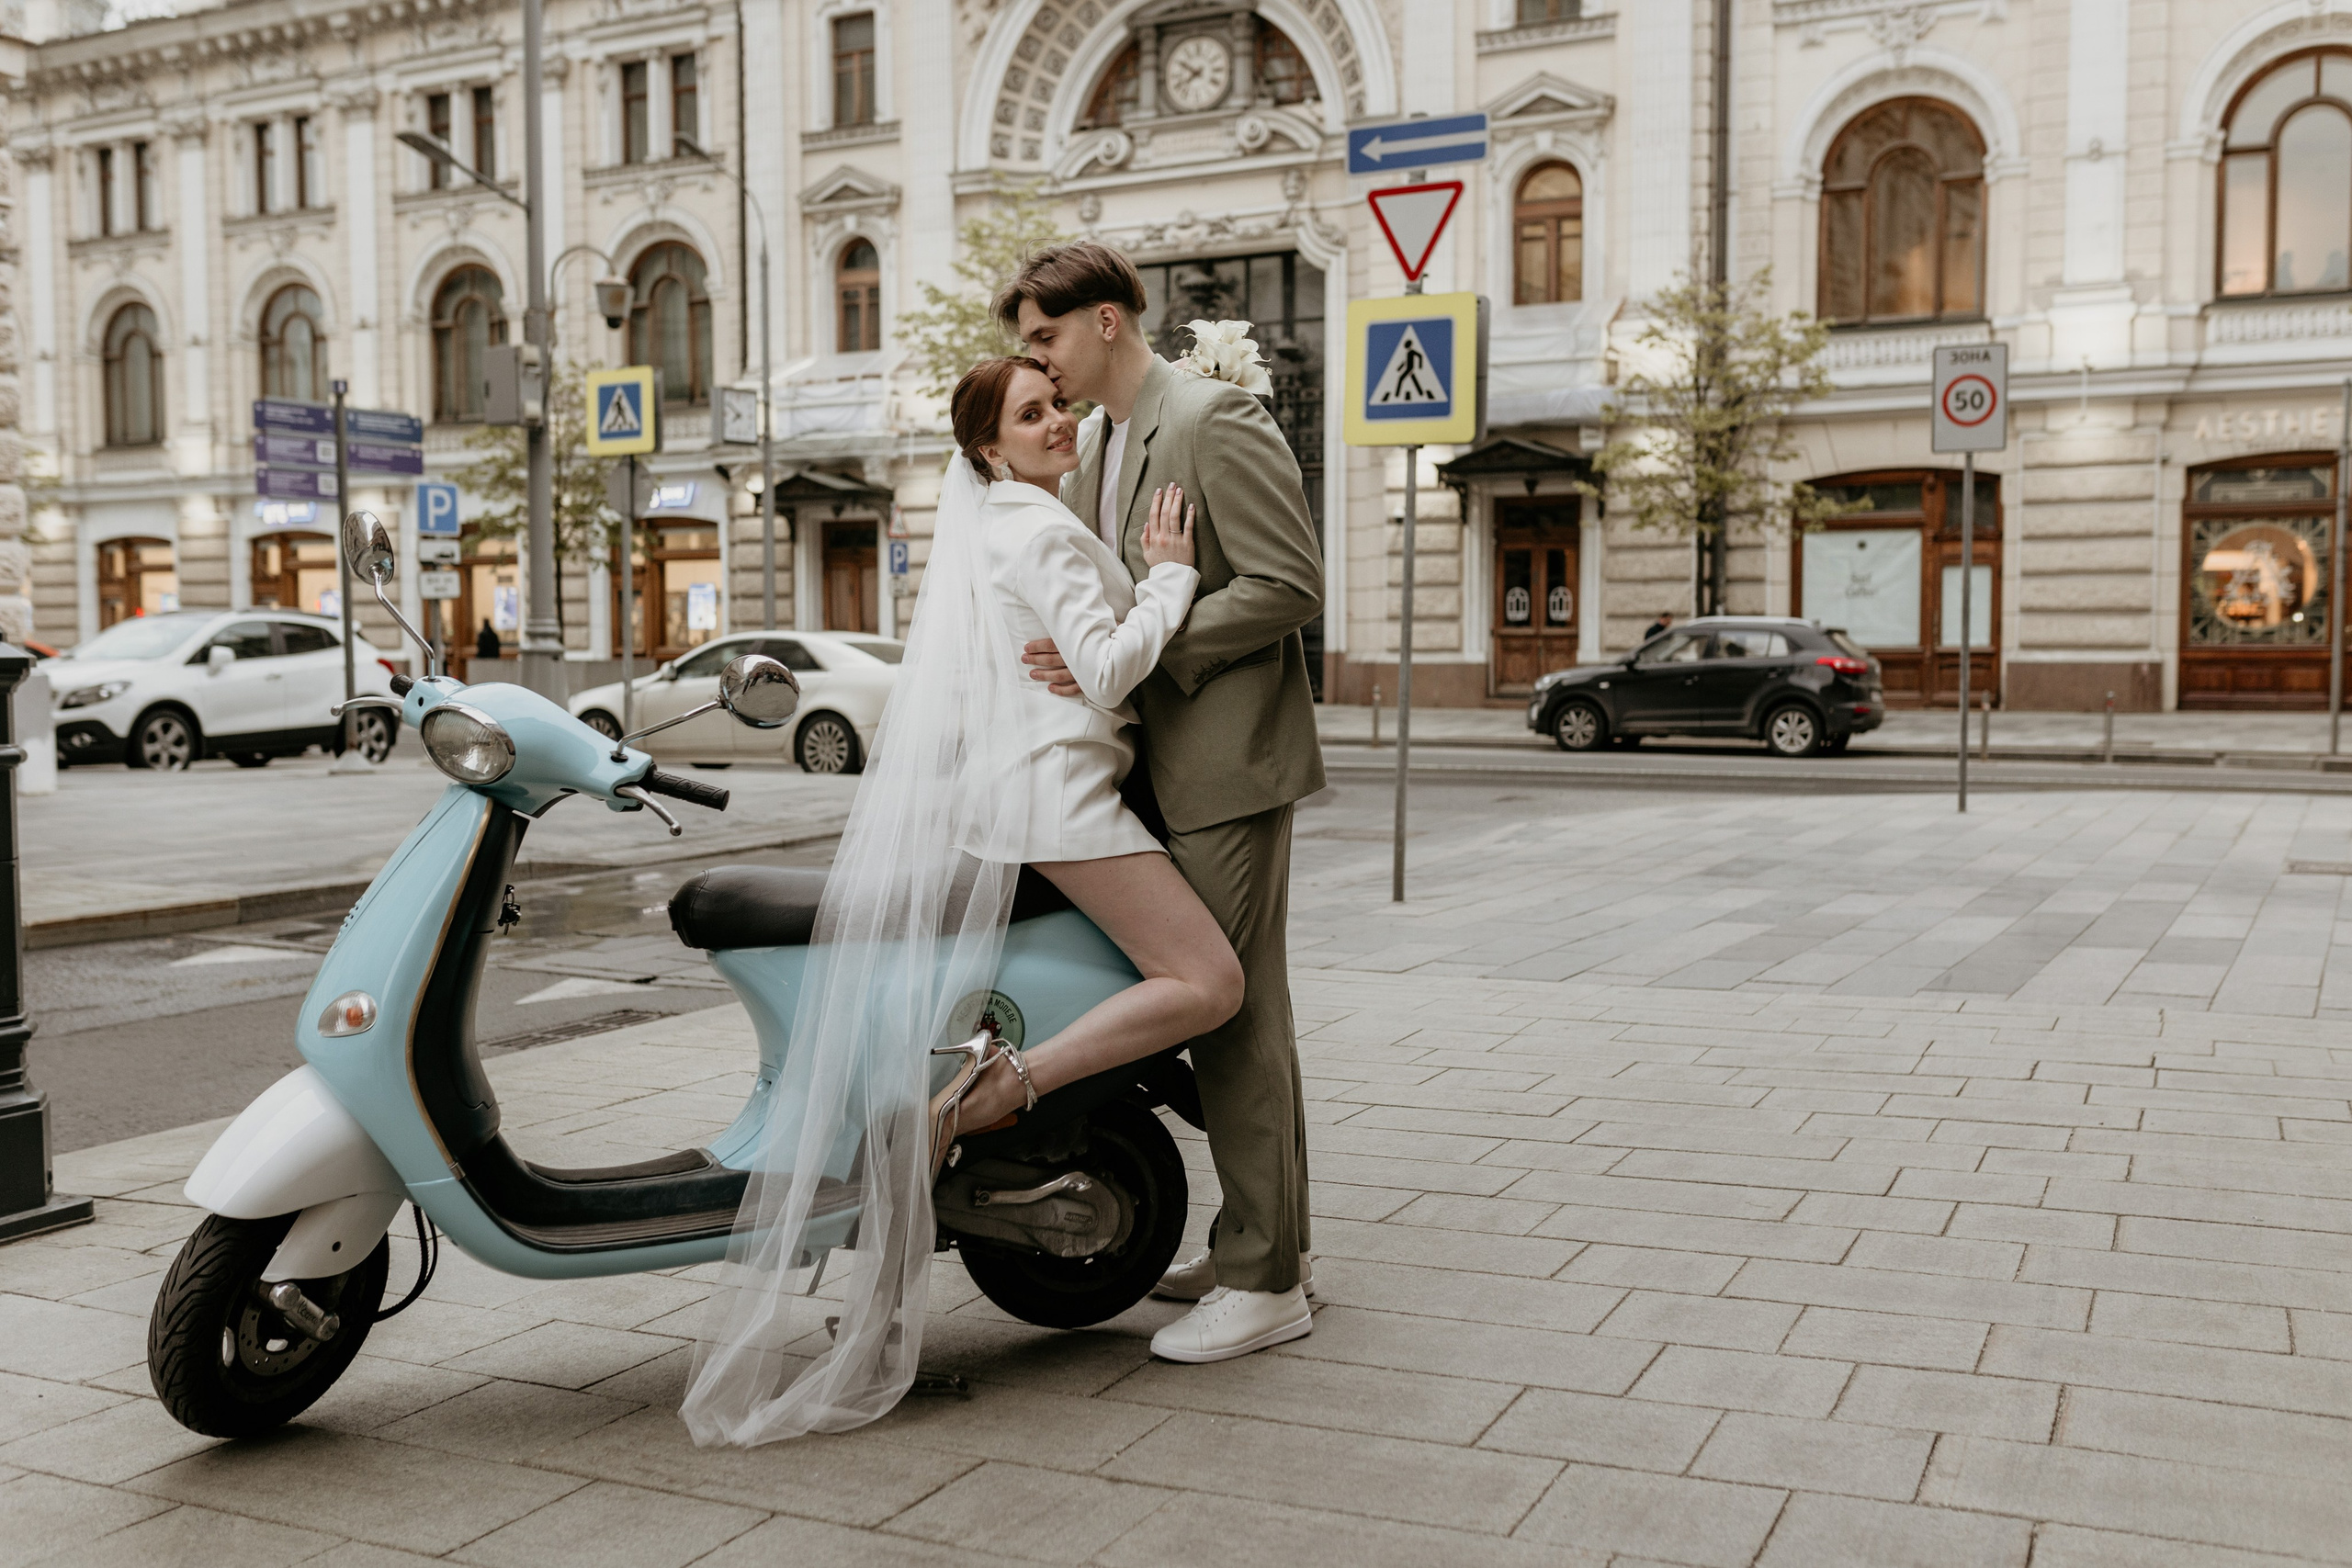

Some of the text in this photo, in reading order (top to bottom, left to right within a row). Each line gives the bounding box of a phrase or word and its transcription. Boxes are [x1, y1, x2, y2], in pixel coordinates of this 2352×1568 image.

[1950, 349, 1992, 366] ЗОНА
[1954, 389, 1985, 412] 50
[427, 488, 452, 530] P
[893, 545, 906, 573] P
